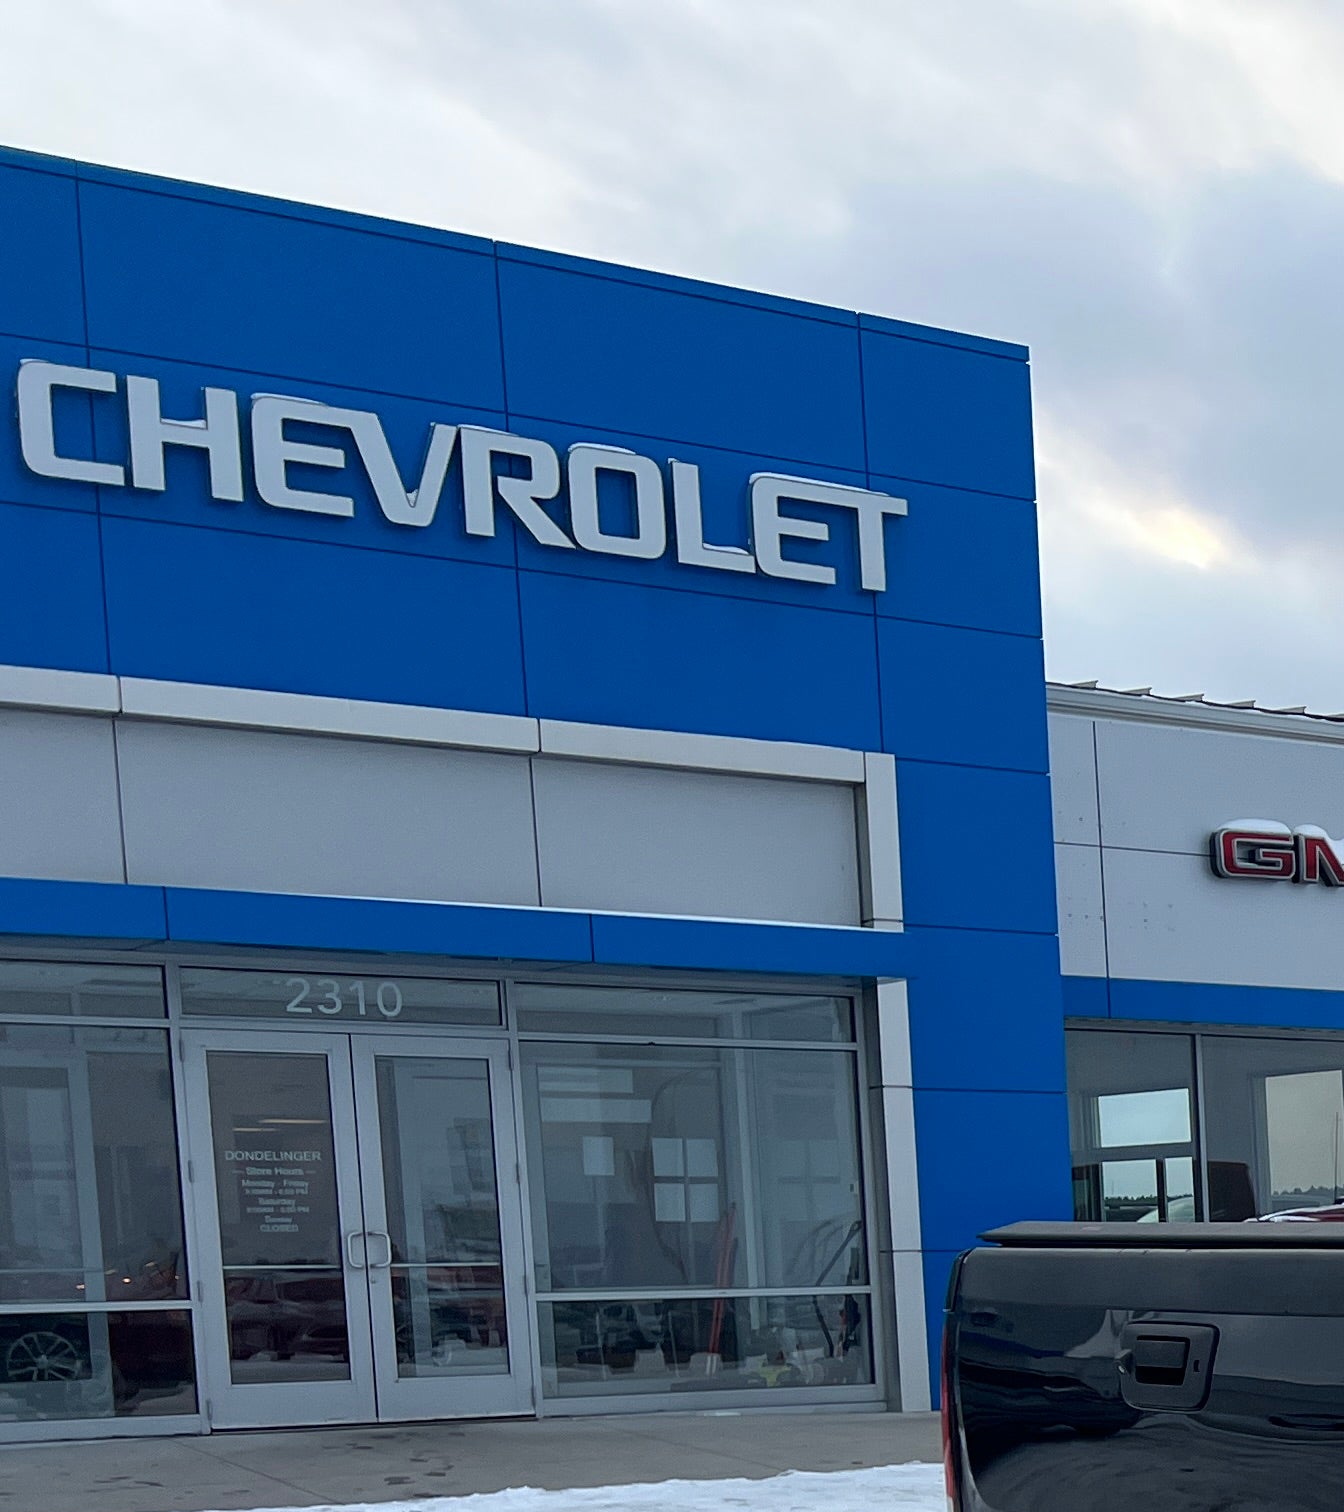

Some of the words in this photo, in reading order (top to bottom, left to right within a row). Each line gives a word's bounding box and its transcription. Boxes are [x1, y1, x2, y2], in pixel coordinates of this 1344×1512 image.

[15, 359, 909, 592] CHEVROLET
[284, 977, 403, 1017] 2310
[224, 1150, 321, 1161] DONDELINGER
